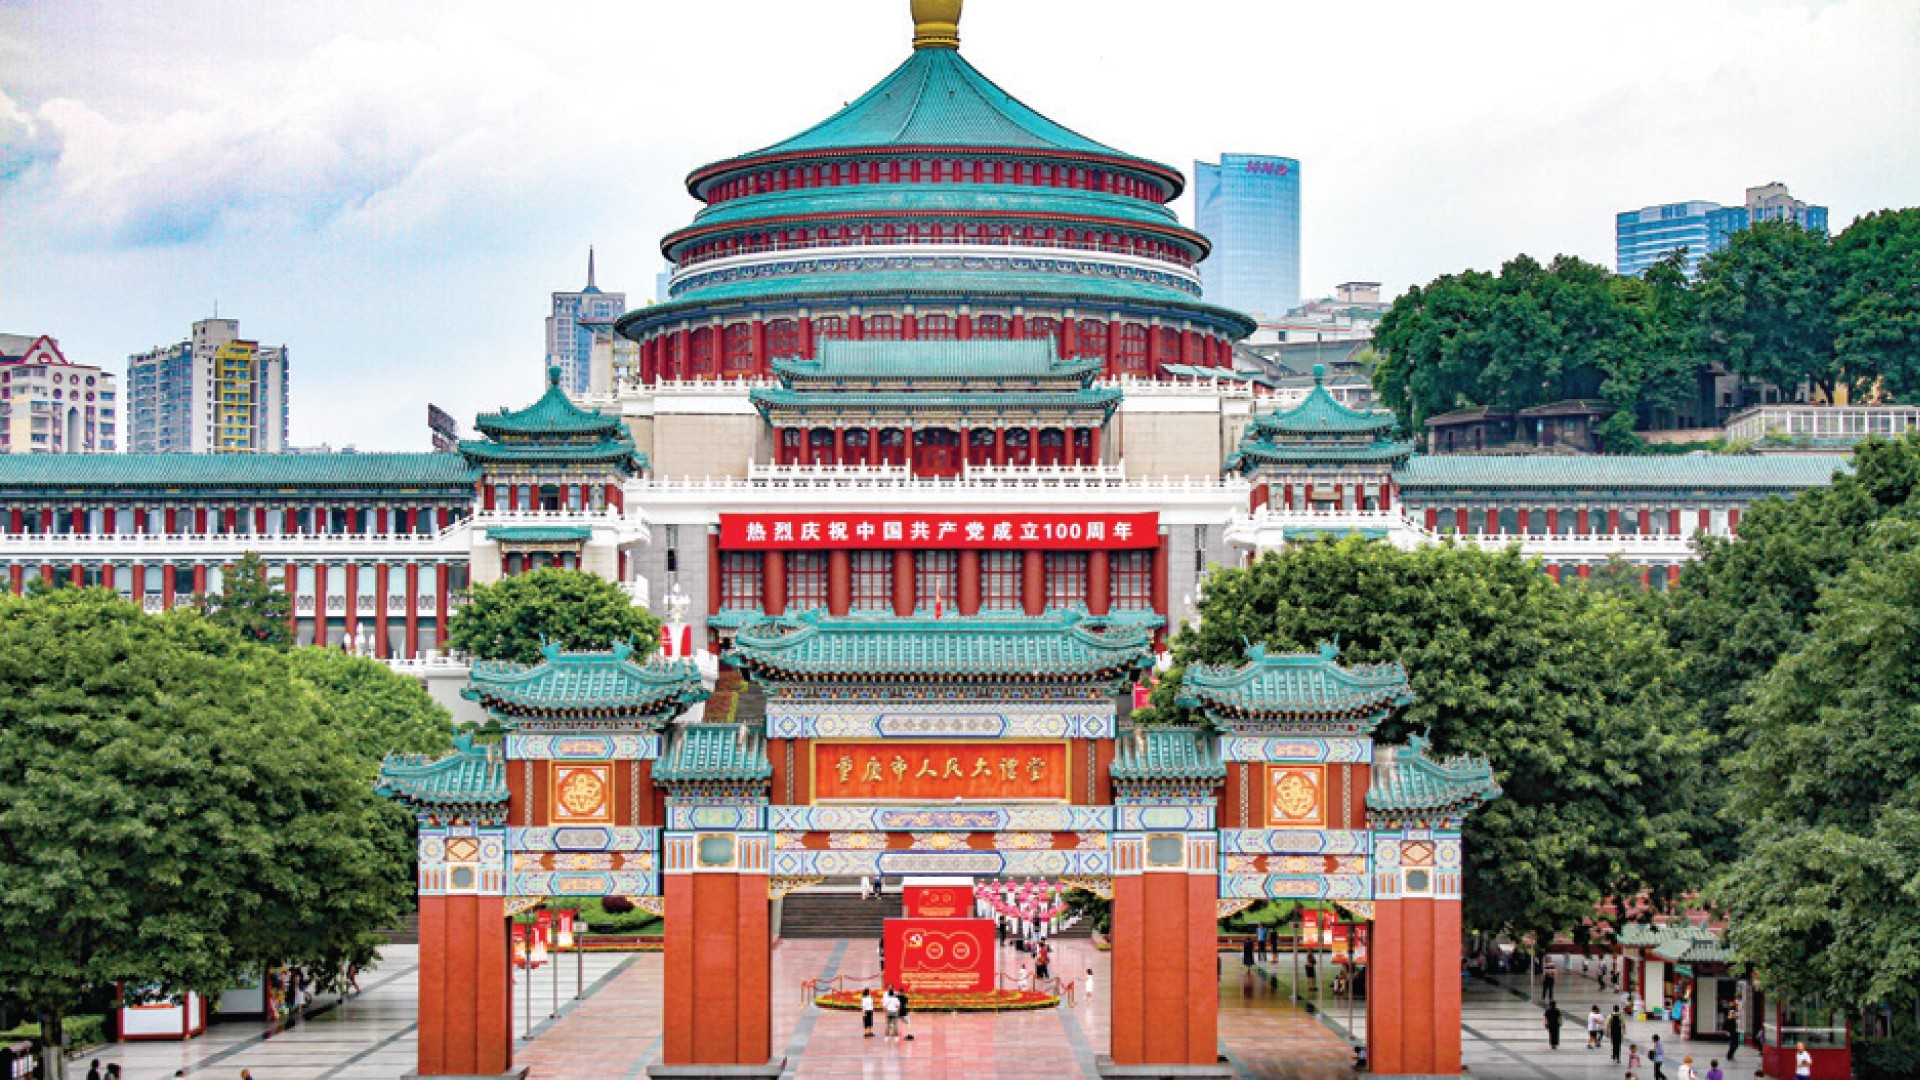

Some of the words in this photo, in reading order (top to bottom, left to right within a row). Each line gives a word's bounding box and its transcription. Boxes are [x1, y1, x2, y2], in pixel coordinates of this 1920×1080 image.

[746, 521, 1134, 542] 热烈庆祝中国共产党成立100周年
